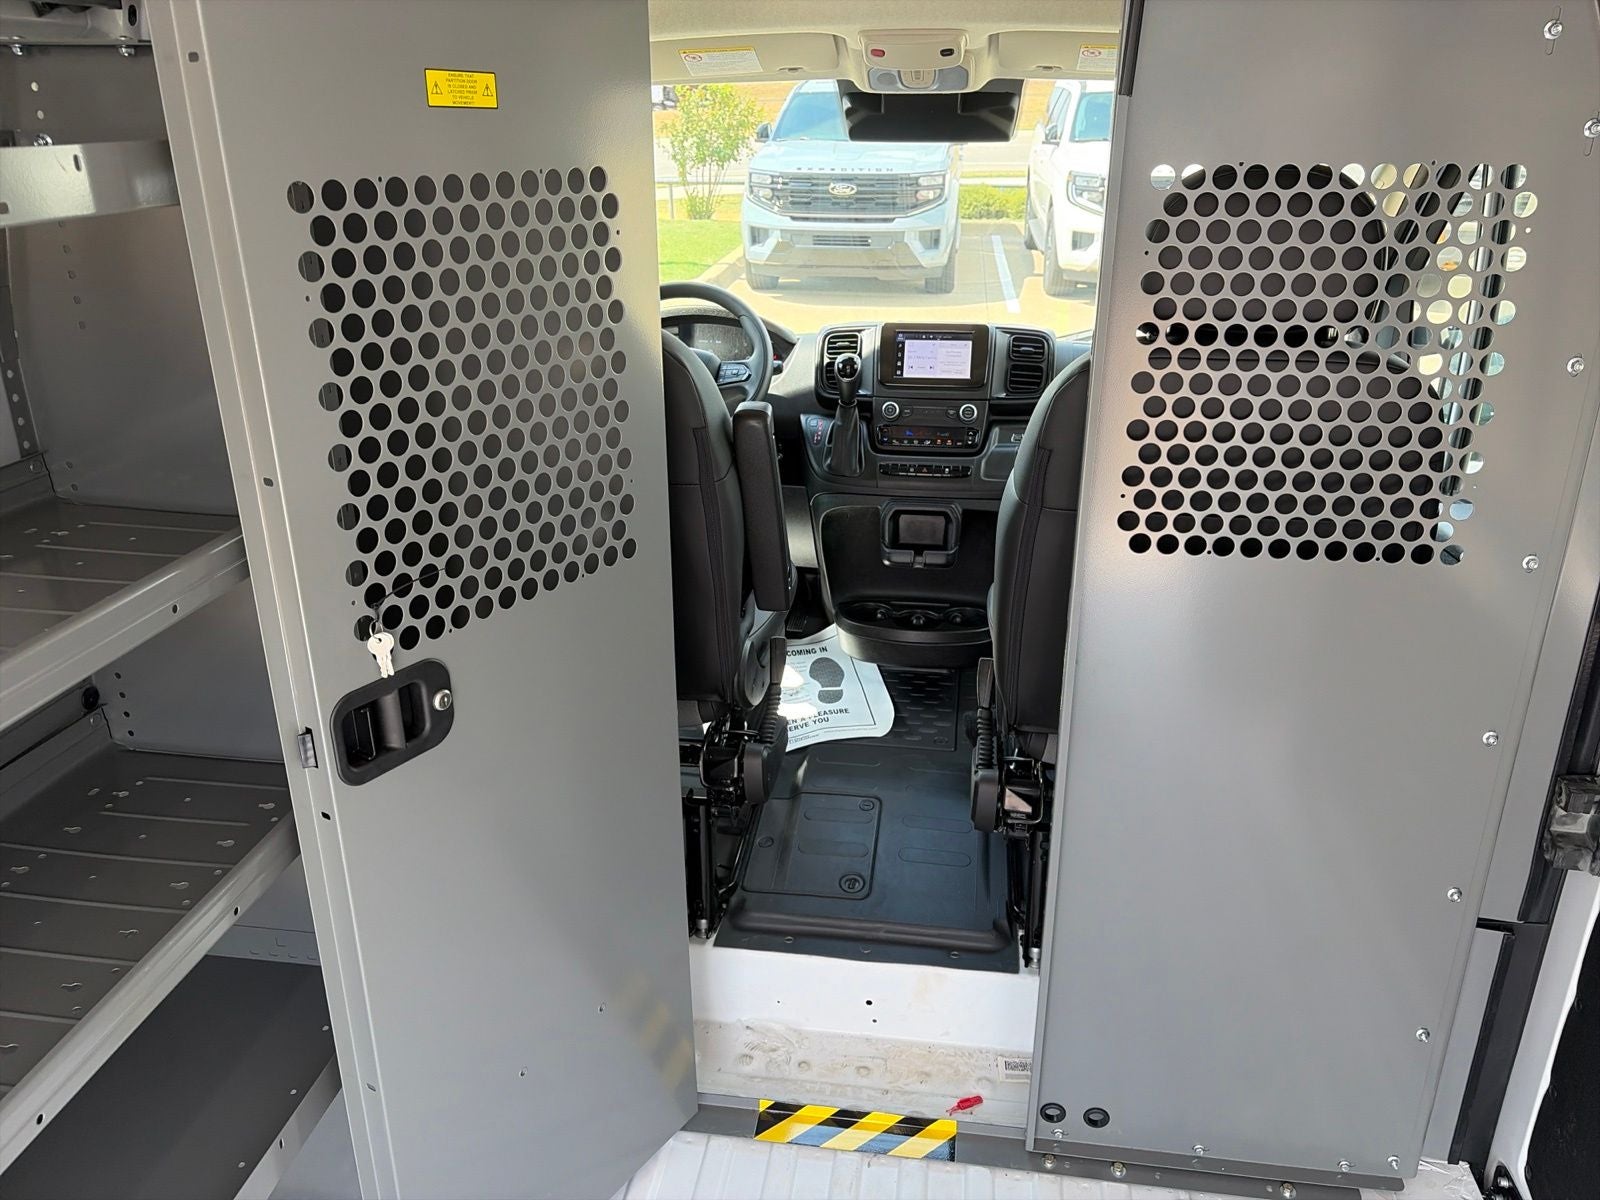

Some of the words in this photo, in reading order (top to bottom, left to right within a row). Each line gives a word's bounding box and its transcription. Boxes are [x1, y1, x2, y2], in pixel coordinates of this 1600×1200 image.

[786, 648, 817, 657] COMING
[808, 708, 850, 720] LEASURE
[788, 722, 809, 732] ERVE
[813, 716, 830, 725] YOU
